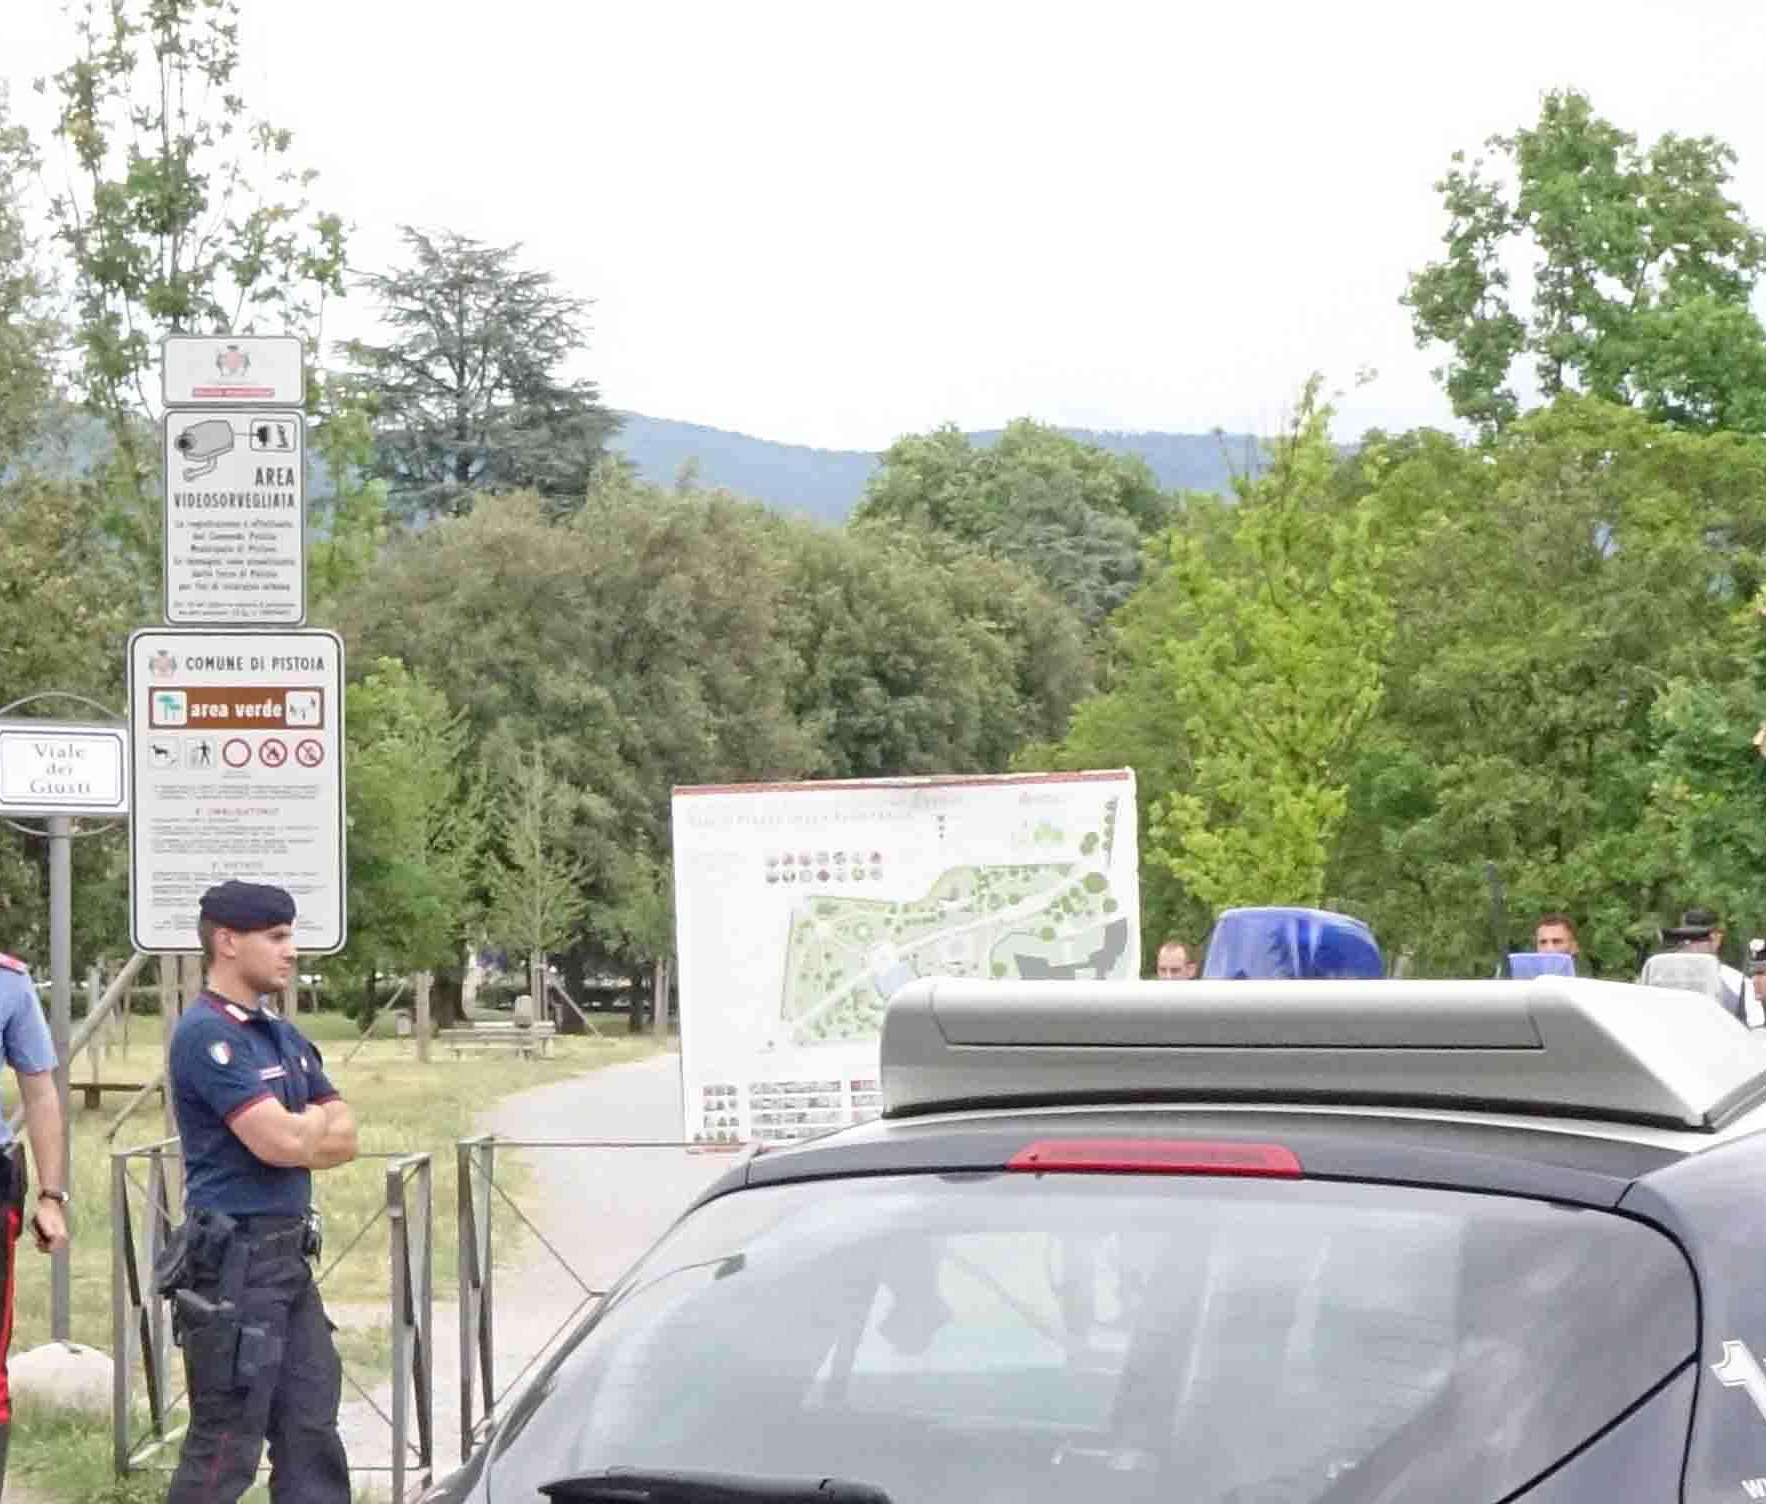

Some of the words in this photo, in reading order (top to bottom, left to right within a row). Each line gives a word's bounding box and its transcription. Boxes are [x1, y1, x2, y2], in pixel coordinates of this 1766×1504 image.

[255, 467, 295, 486] AREA
[174, 491, 296, 508] VIDEOSORVEGLIATA
[186, 656, 244, 671] COMUNE
[250, 656, 265, 671] DI
[272, 656, 325, 671] PISTOIA
[190, 703, 229, 718] area
[234, 697, 283, 718] verde
[33, 743, 85, 759] Viale
[45, 762, 73, 775] dei
[29, 778, 92, 794] Giusti
